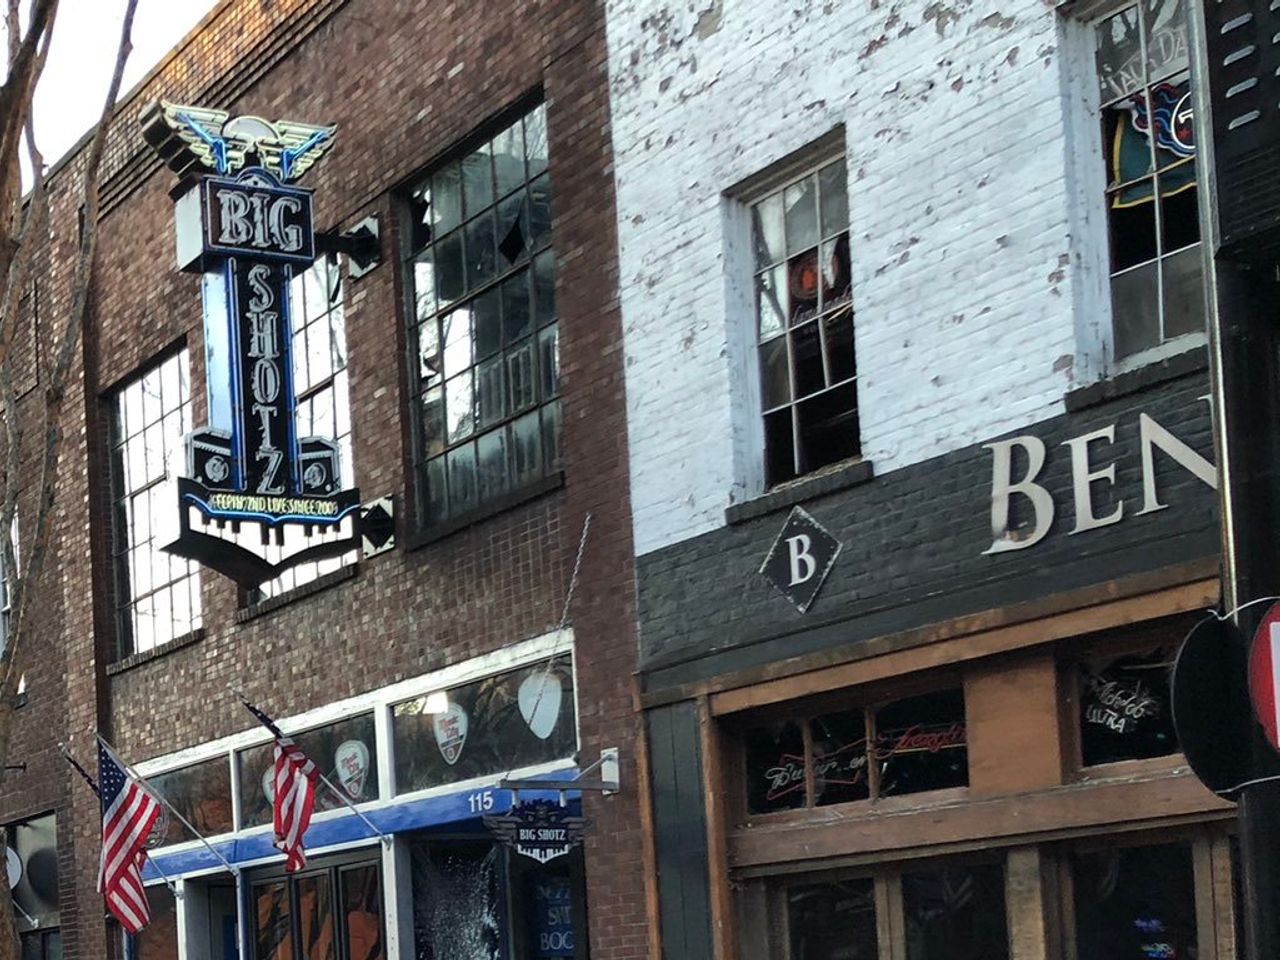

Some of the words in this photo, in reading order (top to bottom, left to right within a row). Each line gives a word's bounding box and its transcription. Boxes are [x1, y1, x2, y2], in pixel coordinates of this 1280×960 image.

[216, 189, 303, 252] BIG
[245, 264, 286, 495] SHOTZ
[784, 534, 817, 588] B
[468, 790, 494, 813] 115
[519, 828, 537, 840] BIG
[537, 828, 566, 840] SHOTZ
